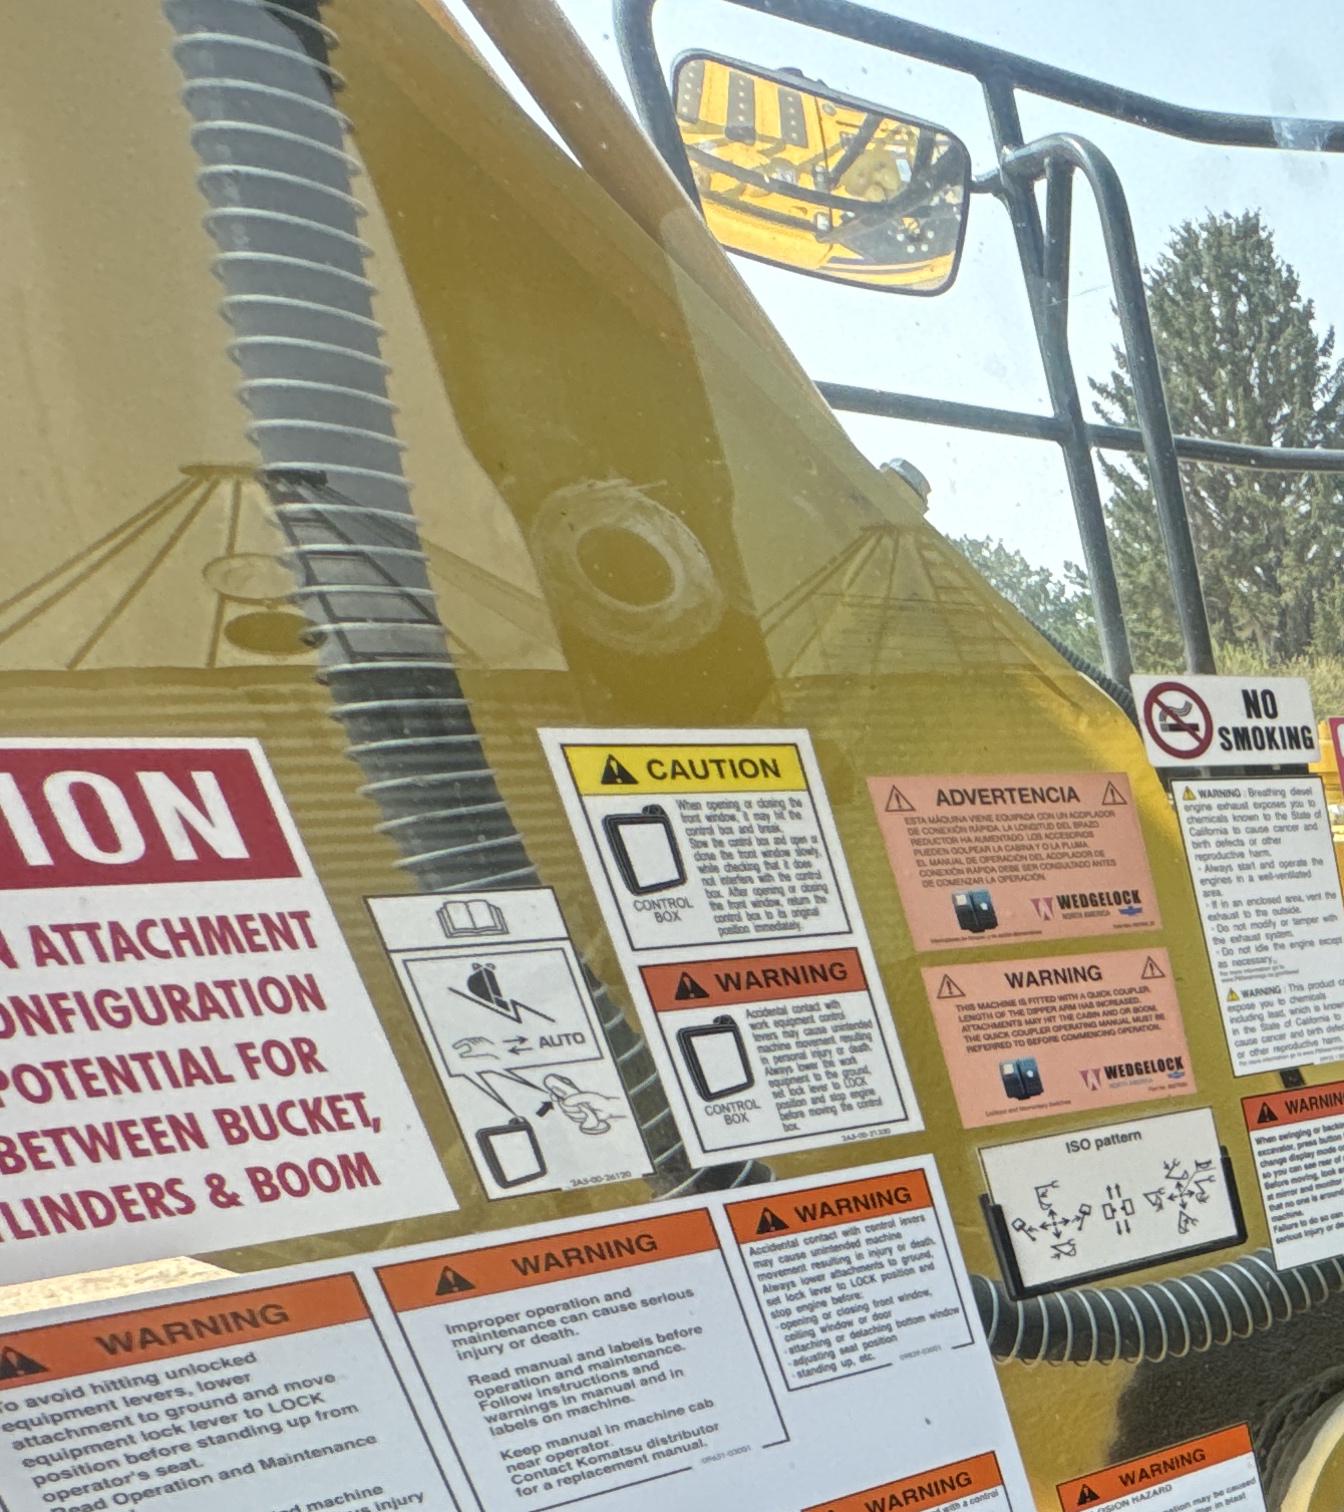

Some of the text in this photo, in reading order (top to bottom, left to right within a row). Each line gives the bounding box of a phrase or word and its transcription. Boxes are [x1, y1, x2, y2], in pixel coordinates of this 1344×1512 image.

[1241, 689, 1278, 719] NO
[1218, 725, 1315, 751] SMOKING
[646, 758, 781, 780] CAUTION
[936, 787, 1080, 807] ADVERTENCIA
[1198, 786, 1312, 798] WARNING Breathing diesel
[633, 897, 693, 912] CONTROL
[654, 911, 682, 923] BOX
[1056, 890, 1140, 909] WEDGELOCK
[28, 911, 318, 968] ATTACHMENT
[714, 962, 848, 992] WARNING
[1005, 966, 1103, 990] WARNING
[539, 1032, 586, 1049] AUTO
[235, 1037, 327, 1080] FOR
[1104, 1056, 1184, 1080] WEDGELOCK
[704, 1100, 762, 1116] CONTROL
[724, 1113, 750, 1126] BOX
[0, 1092, 383, 1175] BETWEEN BUCKET,
[1066, 1130, 1143, 1153] ISO pattern
[0, 1152, 381, 1242] LINDERS & BOOM
[794, 1186, 912, 1223] WARNING
[749, 1214, 925, 1256] Accidental contact with control levers
[511, 1234, 658, 1276] WARNING
[445, 1287, 632, 1335] Improper operation and
[451, 1288, 695, 1348] maintenance can cause serious
[95, 1302, 289, 1356] WARNING
[456, 1327, 580, 1361] injury or death.
[26, 1352, 257, 1409] avoid hitting unlocked
[2, 1372, 251, 1433] equipment levers, lower
[12, 1373, 336, 1451] attachment to ground and move
[21, 1393, 326, 1469] equipment lock lever to LOCK
[32, 1403, 359, 1489] position before standing up from
[112, 1475, 214, 1505] Operation
[218, 1463, 255, 1481] and
[259, 1434, 378, 1470] Maintenance
[511, 1423, 720, 1485] Contact Komatsu distributor
[1119, 1448, 1206, 1487] WARNING
[42, 1457, 204, 1503] operator's seat.
[1132, 1484, 1173, 1503] HAZARD
[306, 1485, 384, 1512] machine
[375, 1491, 425, 1512] injury
